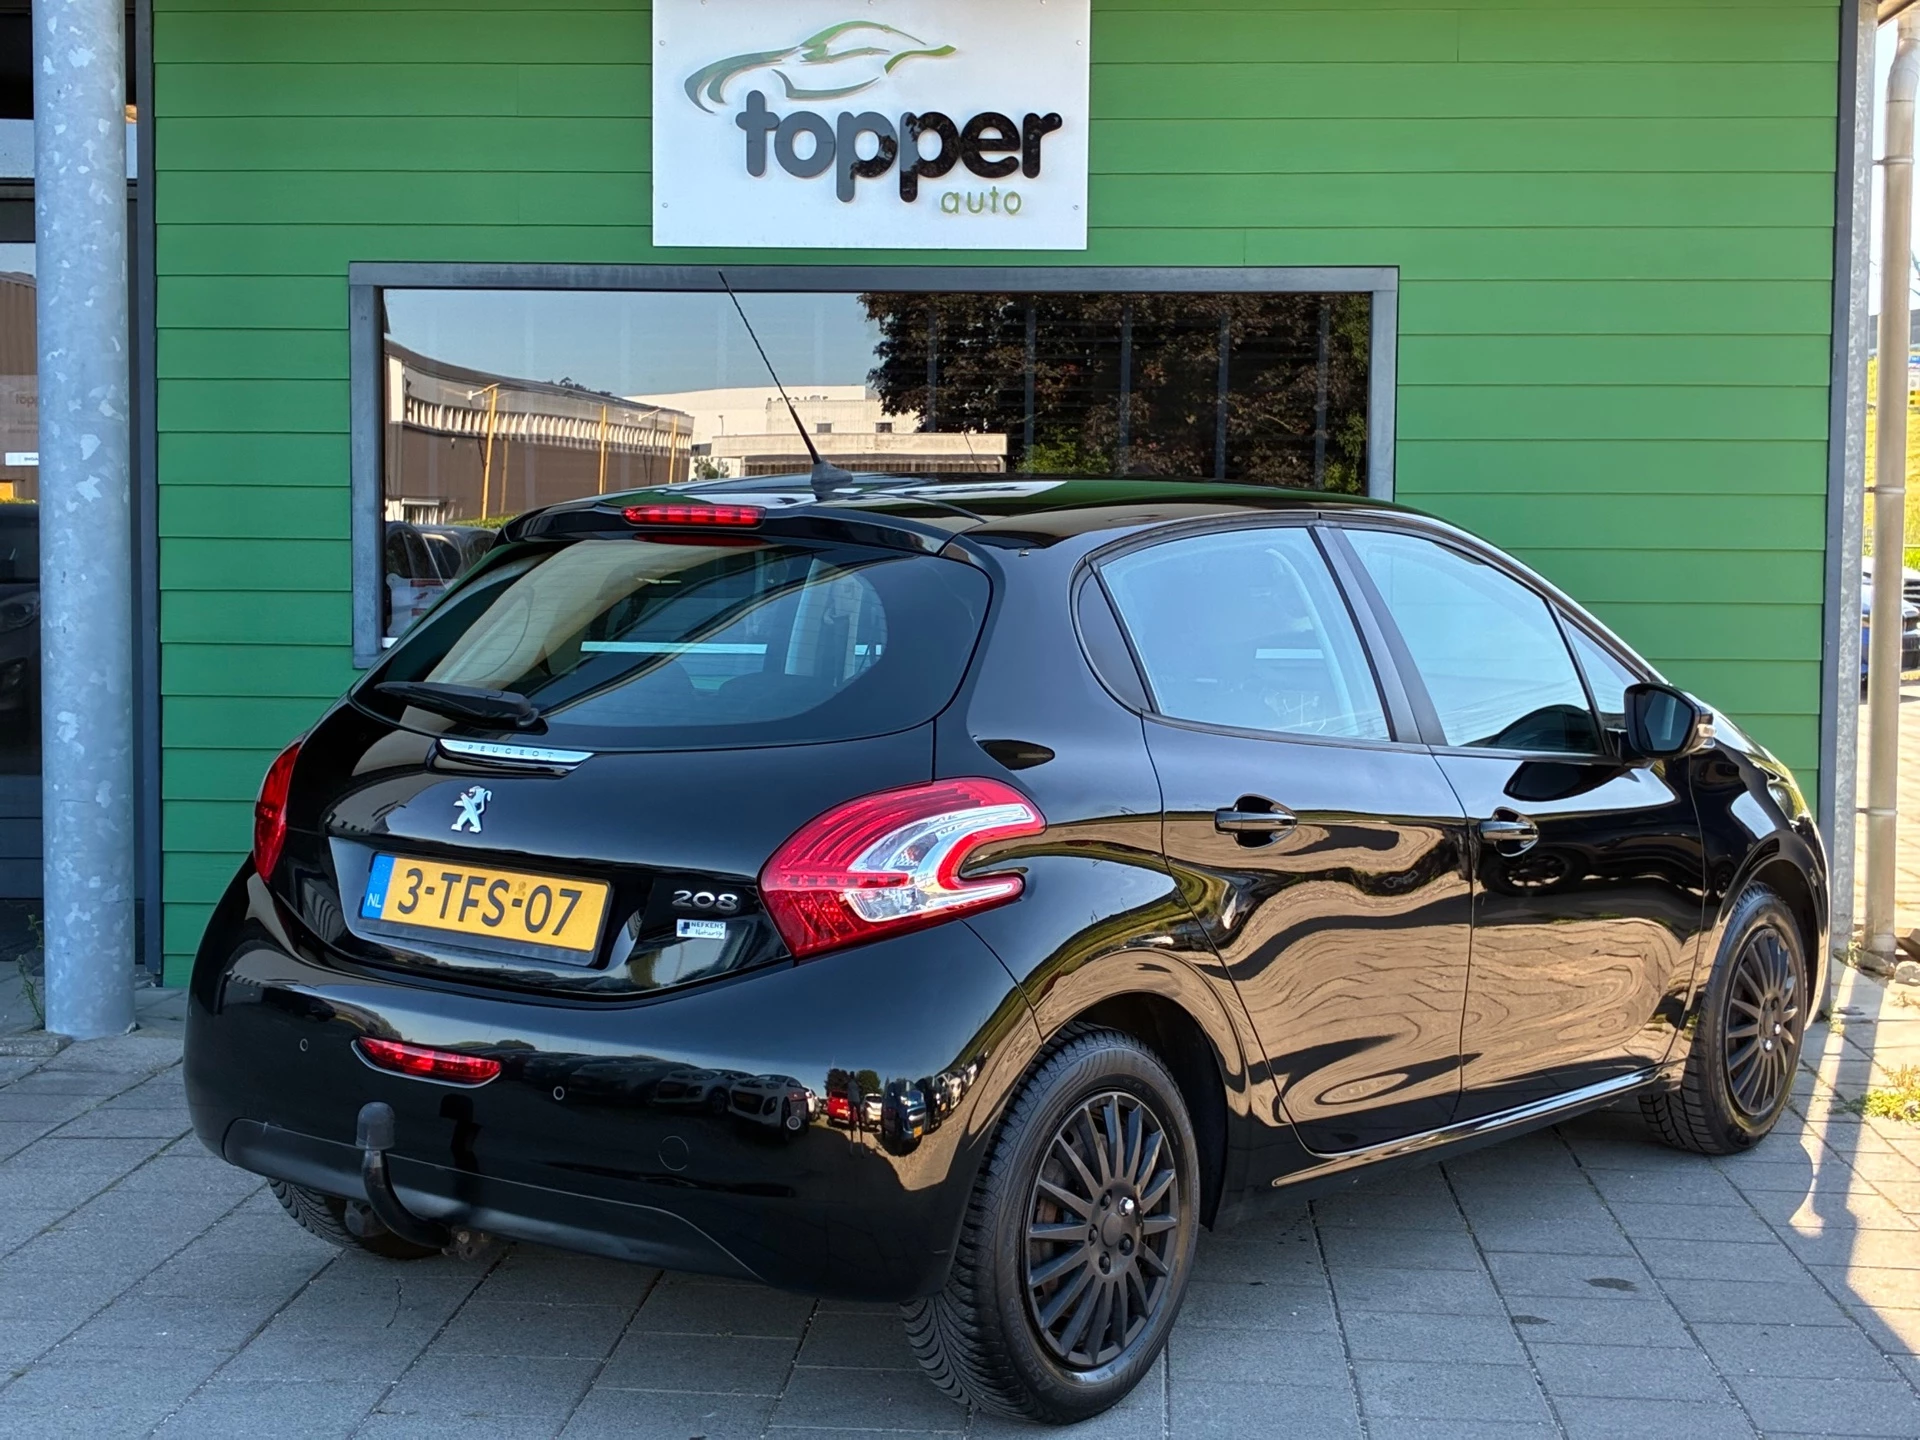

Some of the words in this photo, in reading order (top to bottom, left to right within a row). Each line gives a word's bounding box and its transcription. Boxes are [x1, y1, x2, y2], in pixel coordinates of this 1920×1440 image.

[735, 89, 1063, 203] topper
[940, 185, 1022, 215] auto
[467, 744, 554, 759] PEUGEOT
[367, 892, 382, 909] NL
[397, 867, 583, 936] 3-TFS-07
[672, 890, 738, 911] 208
